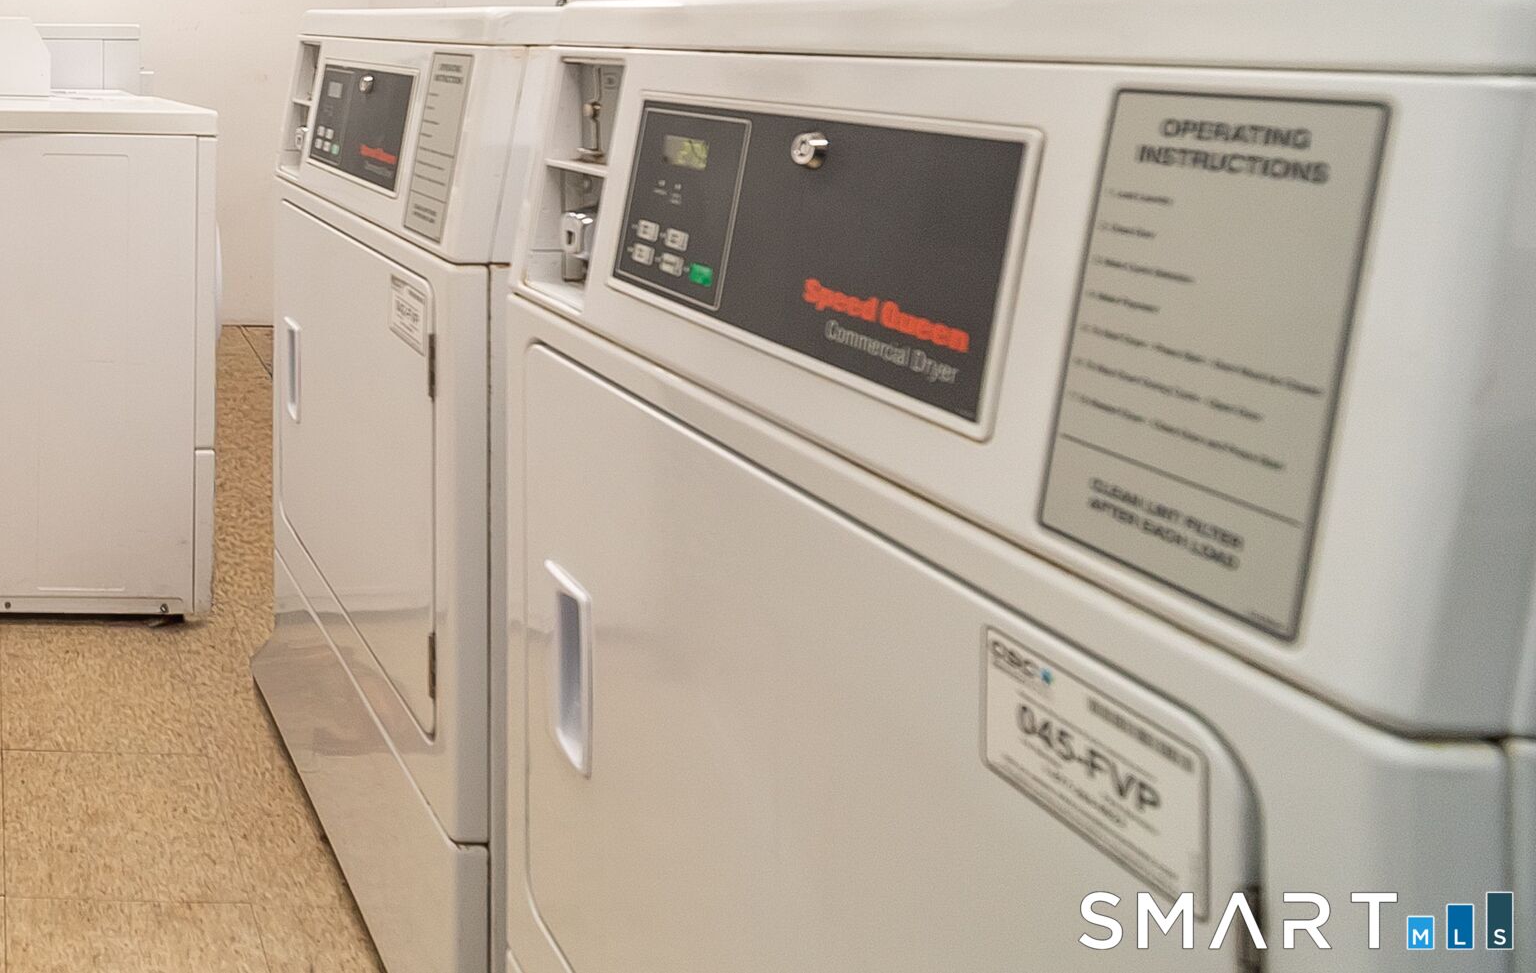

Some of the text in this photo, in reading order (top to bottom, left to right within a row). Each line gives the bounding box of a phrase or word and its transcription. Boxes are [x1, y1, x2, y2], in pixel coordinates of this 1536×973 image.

[1136, 145, 1330, 184] INSTRUCTIONS
[1161, 118, 1312, 150] OPERATING
[802, 278, 970, 353] Speed Queen
[825, 319, 959, 384] Commercial Dryer
[1087, 495, 1240, 571] AFTER EACH LOAD
[1090, 478, 1245, 551] CLEAN LINT FILTER
[1016, 703, 1162, 812] 045-FVP
